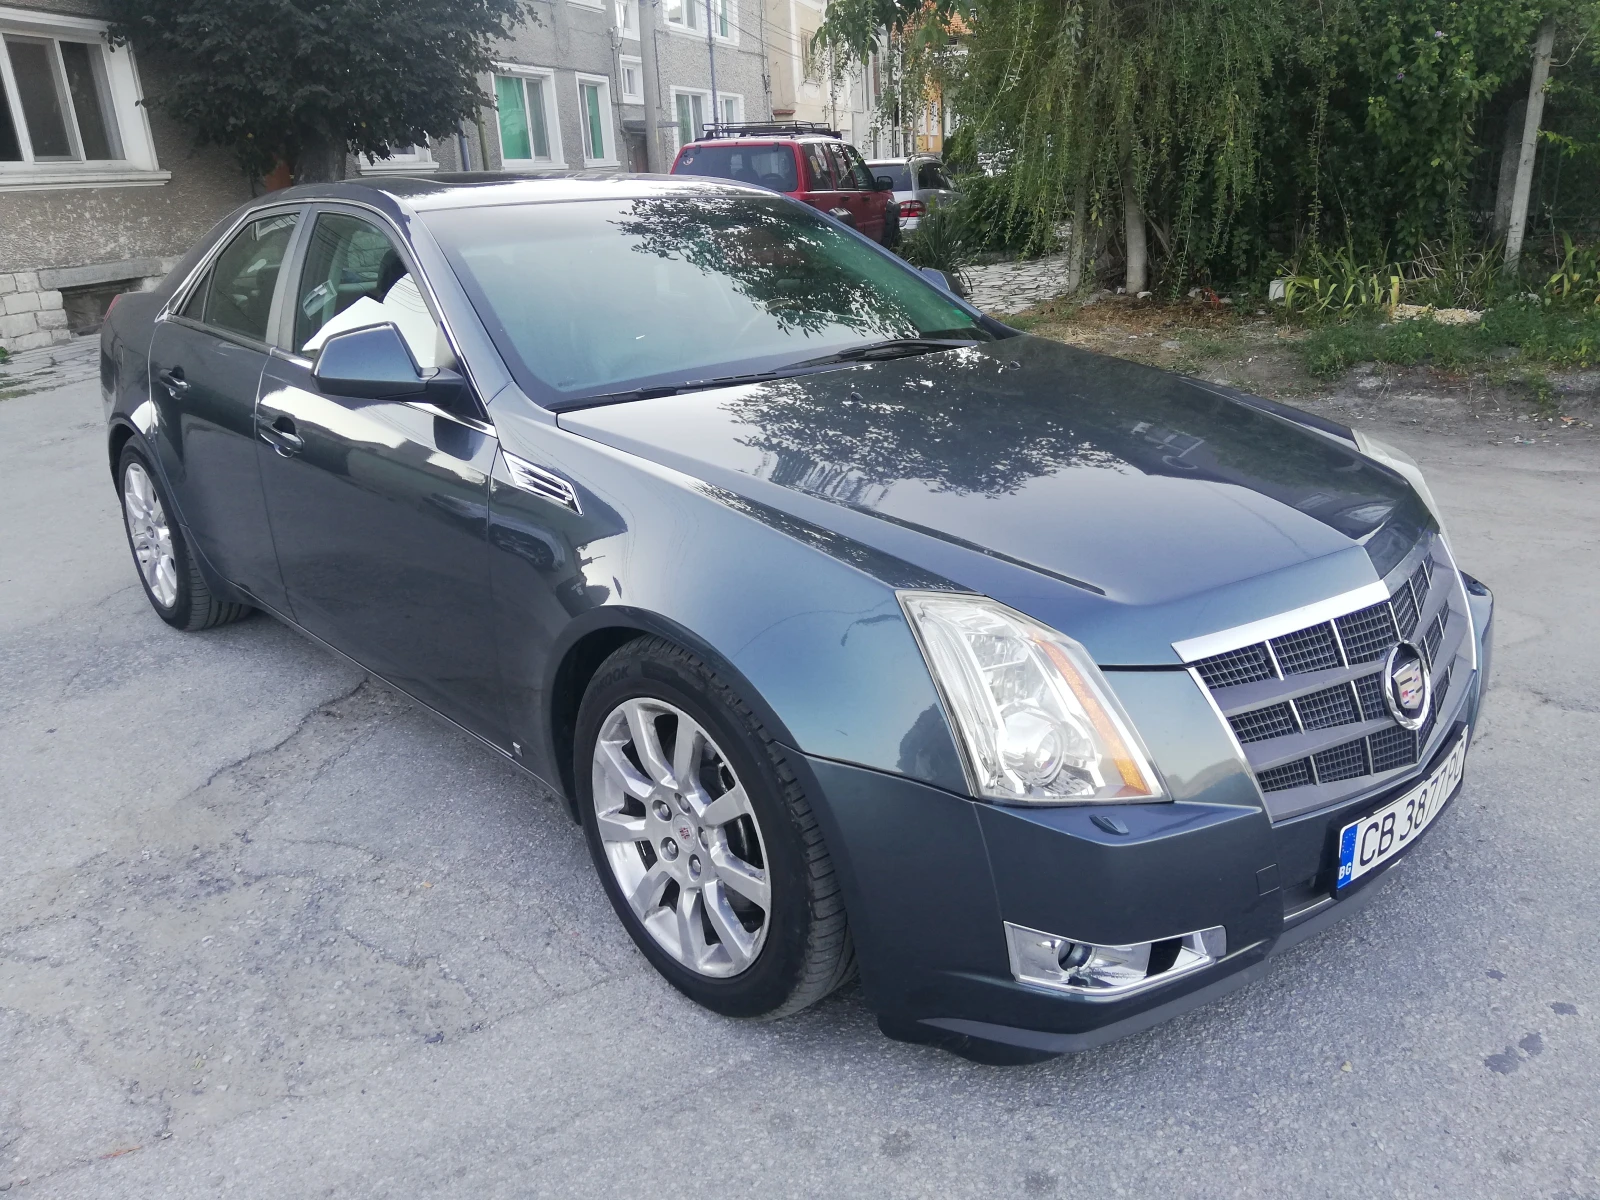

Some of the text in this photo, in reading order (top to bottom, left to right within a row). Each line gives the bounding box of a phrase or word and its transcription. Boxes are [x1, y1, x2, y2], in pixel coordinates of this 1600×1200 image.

[1360, 811, 1396, 866] CB
[1399, 764, 1449, 841] 3877
[1338, 862, 1352, 880] BG
